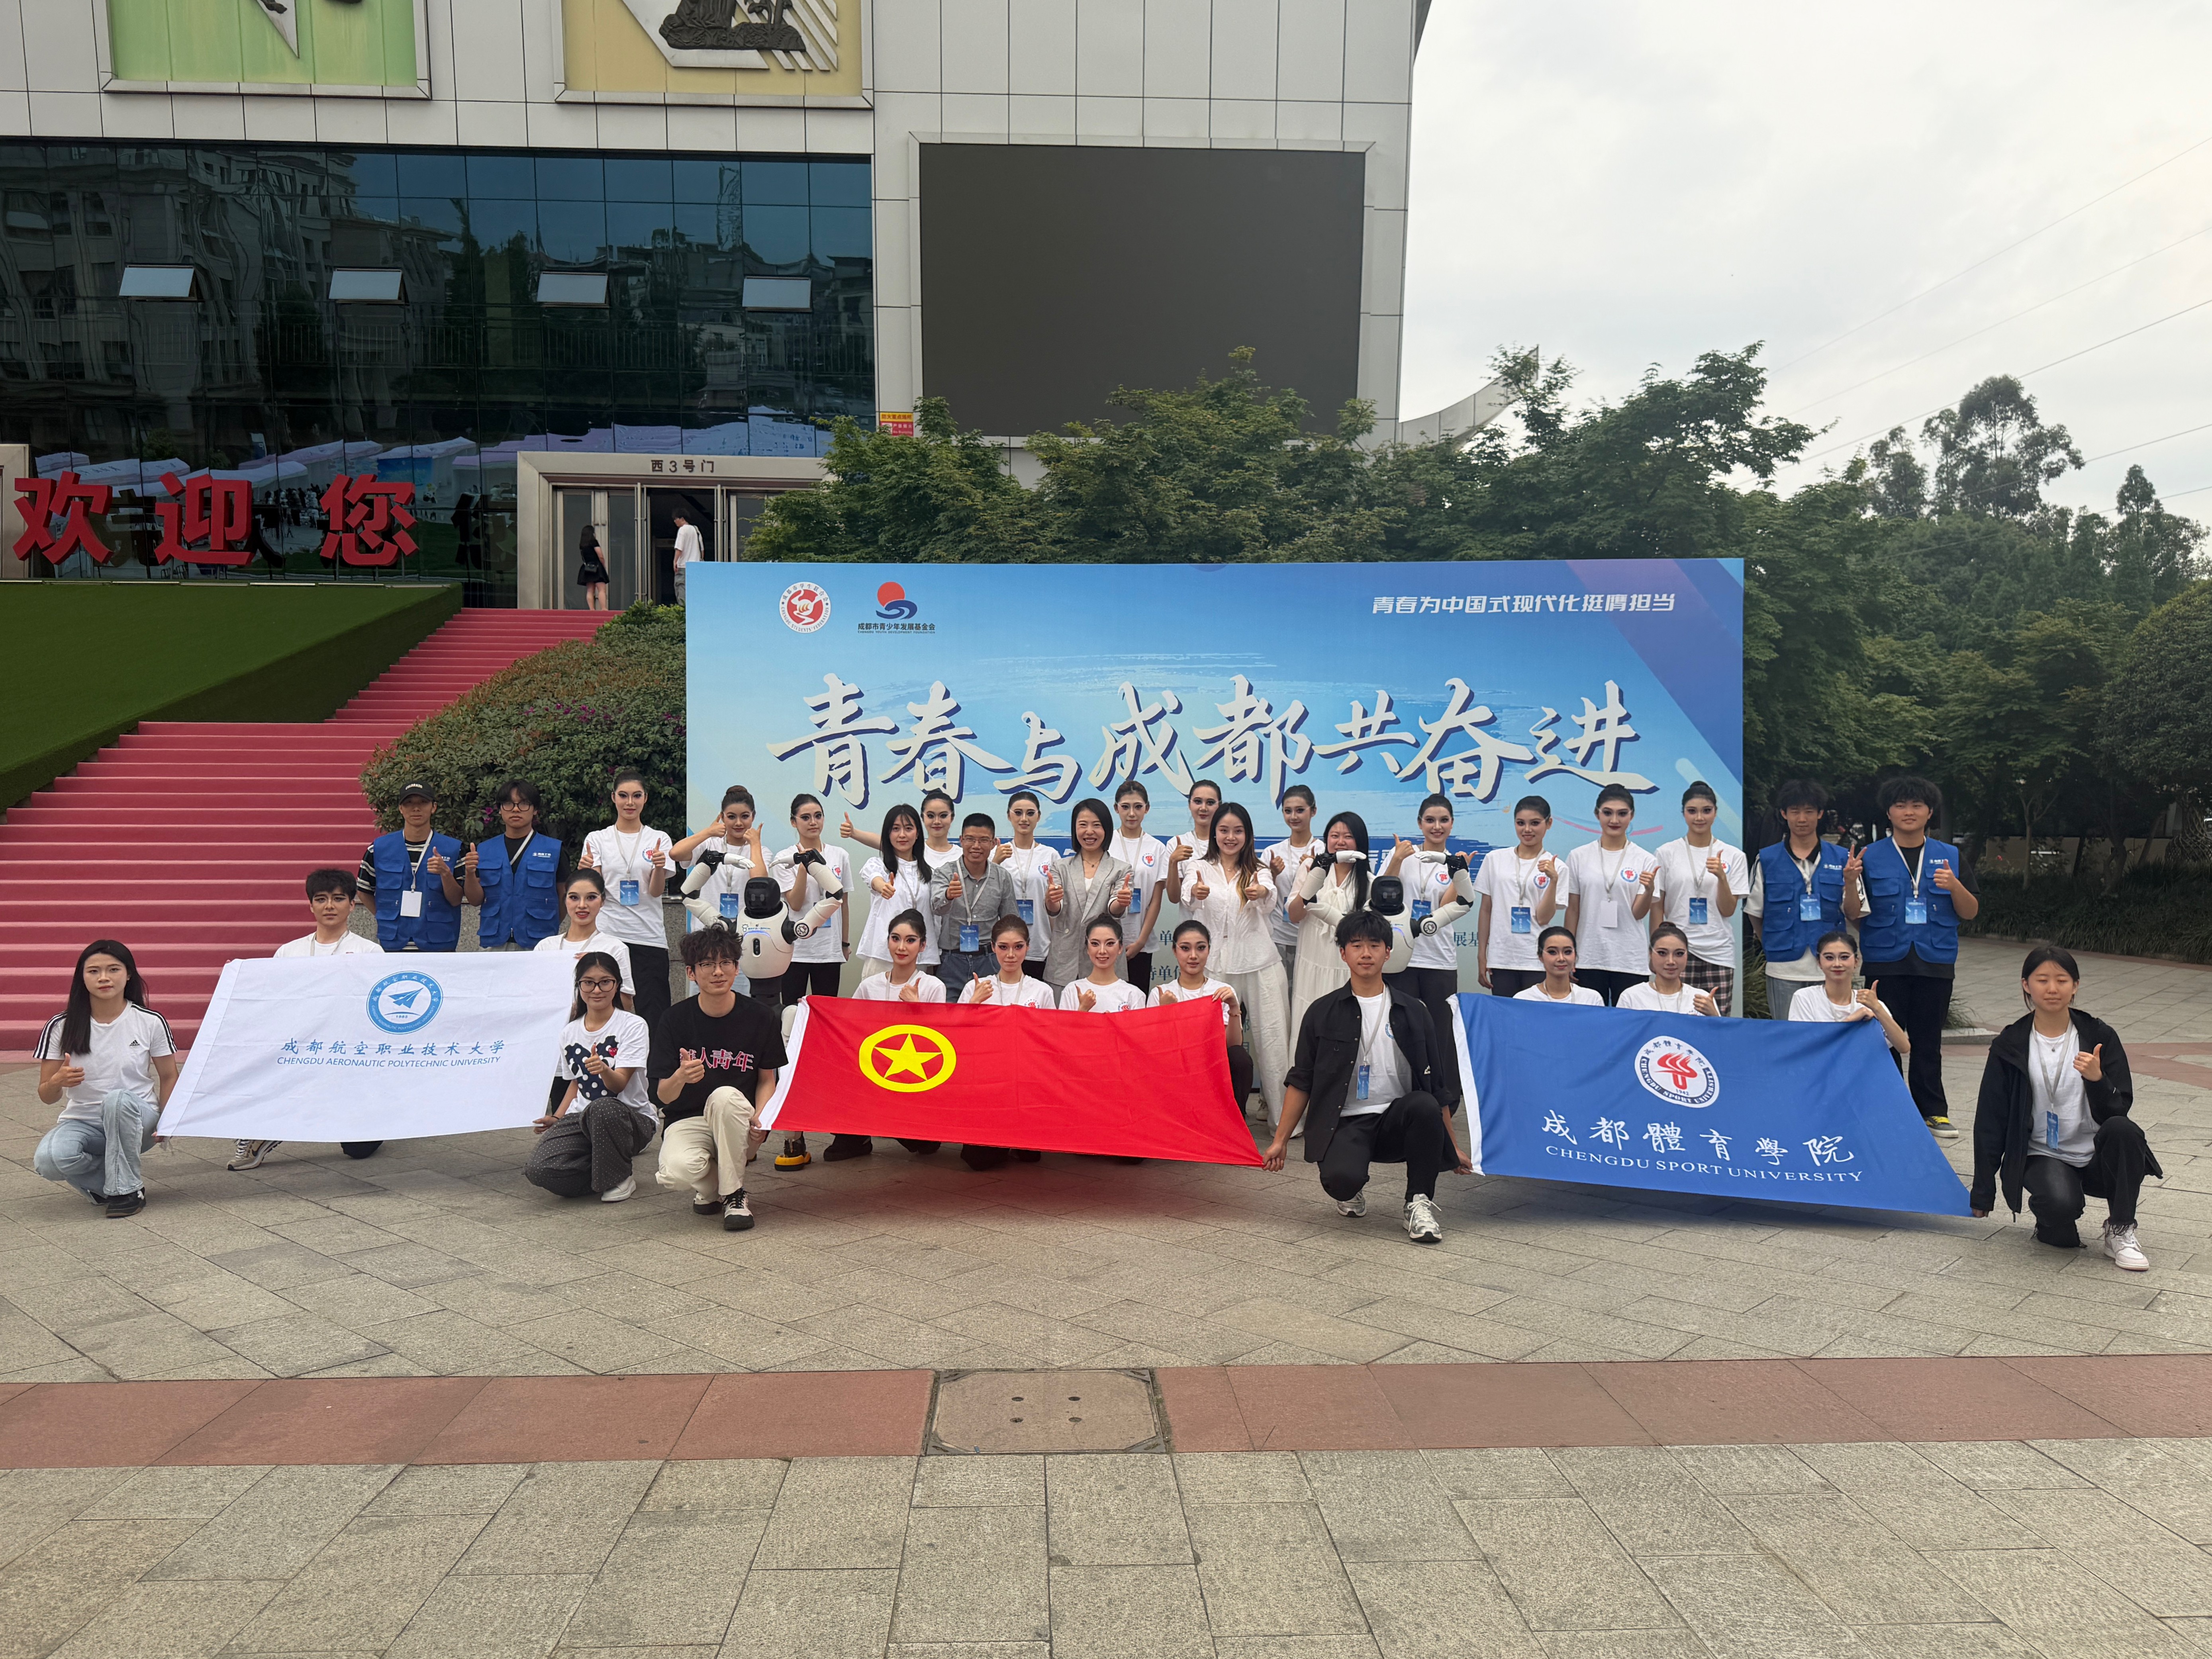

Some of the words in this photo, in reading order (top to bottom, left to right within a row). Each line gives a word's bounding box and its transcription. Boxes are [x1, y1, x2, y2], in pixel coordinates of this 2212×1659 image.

[651, 460, 714, 473] 西3号门
[13, 471, 419, 566] 欢迎您
[1372, 593, 1675, 614] 青春为中国式现代化挺膺担当
[766, 672, 1661, 810] 青春与成都共奋进
[280, 1038, 505, 1056] 成都航空职业技术大学
[325, 1058, 386, 1067] AERONAUTIC
[451, 1056, 501, 1066] UNIVERSITY
[1641, 1058, 1661, 1091] CHENGDU
[1663, 1090, 1692, 1103] SPORT
[1542, 1109, 1854, 1167] 成都體育學院
[1546, 1146, 1650, 1169] CHENGDU
[1656, 1160, 1722, 1175] SPORT
[1727, 1167, 1863, 1182] UNIVERSITY
